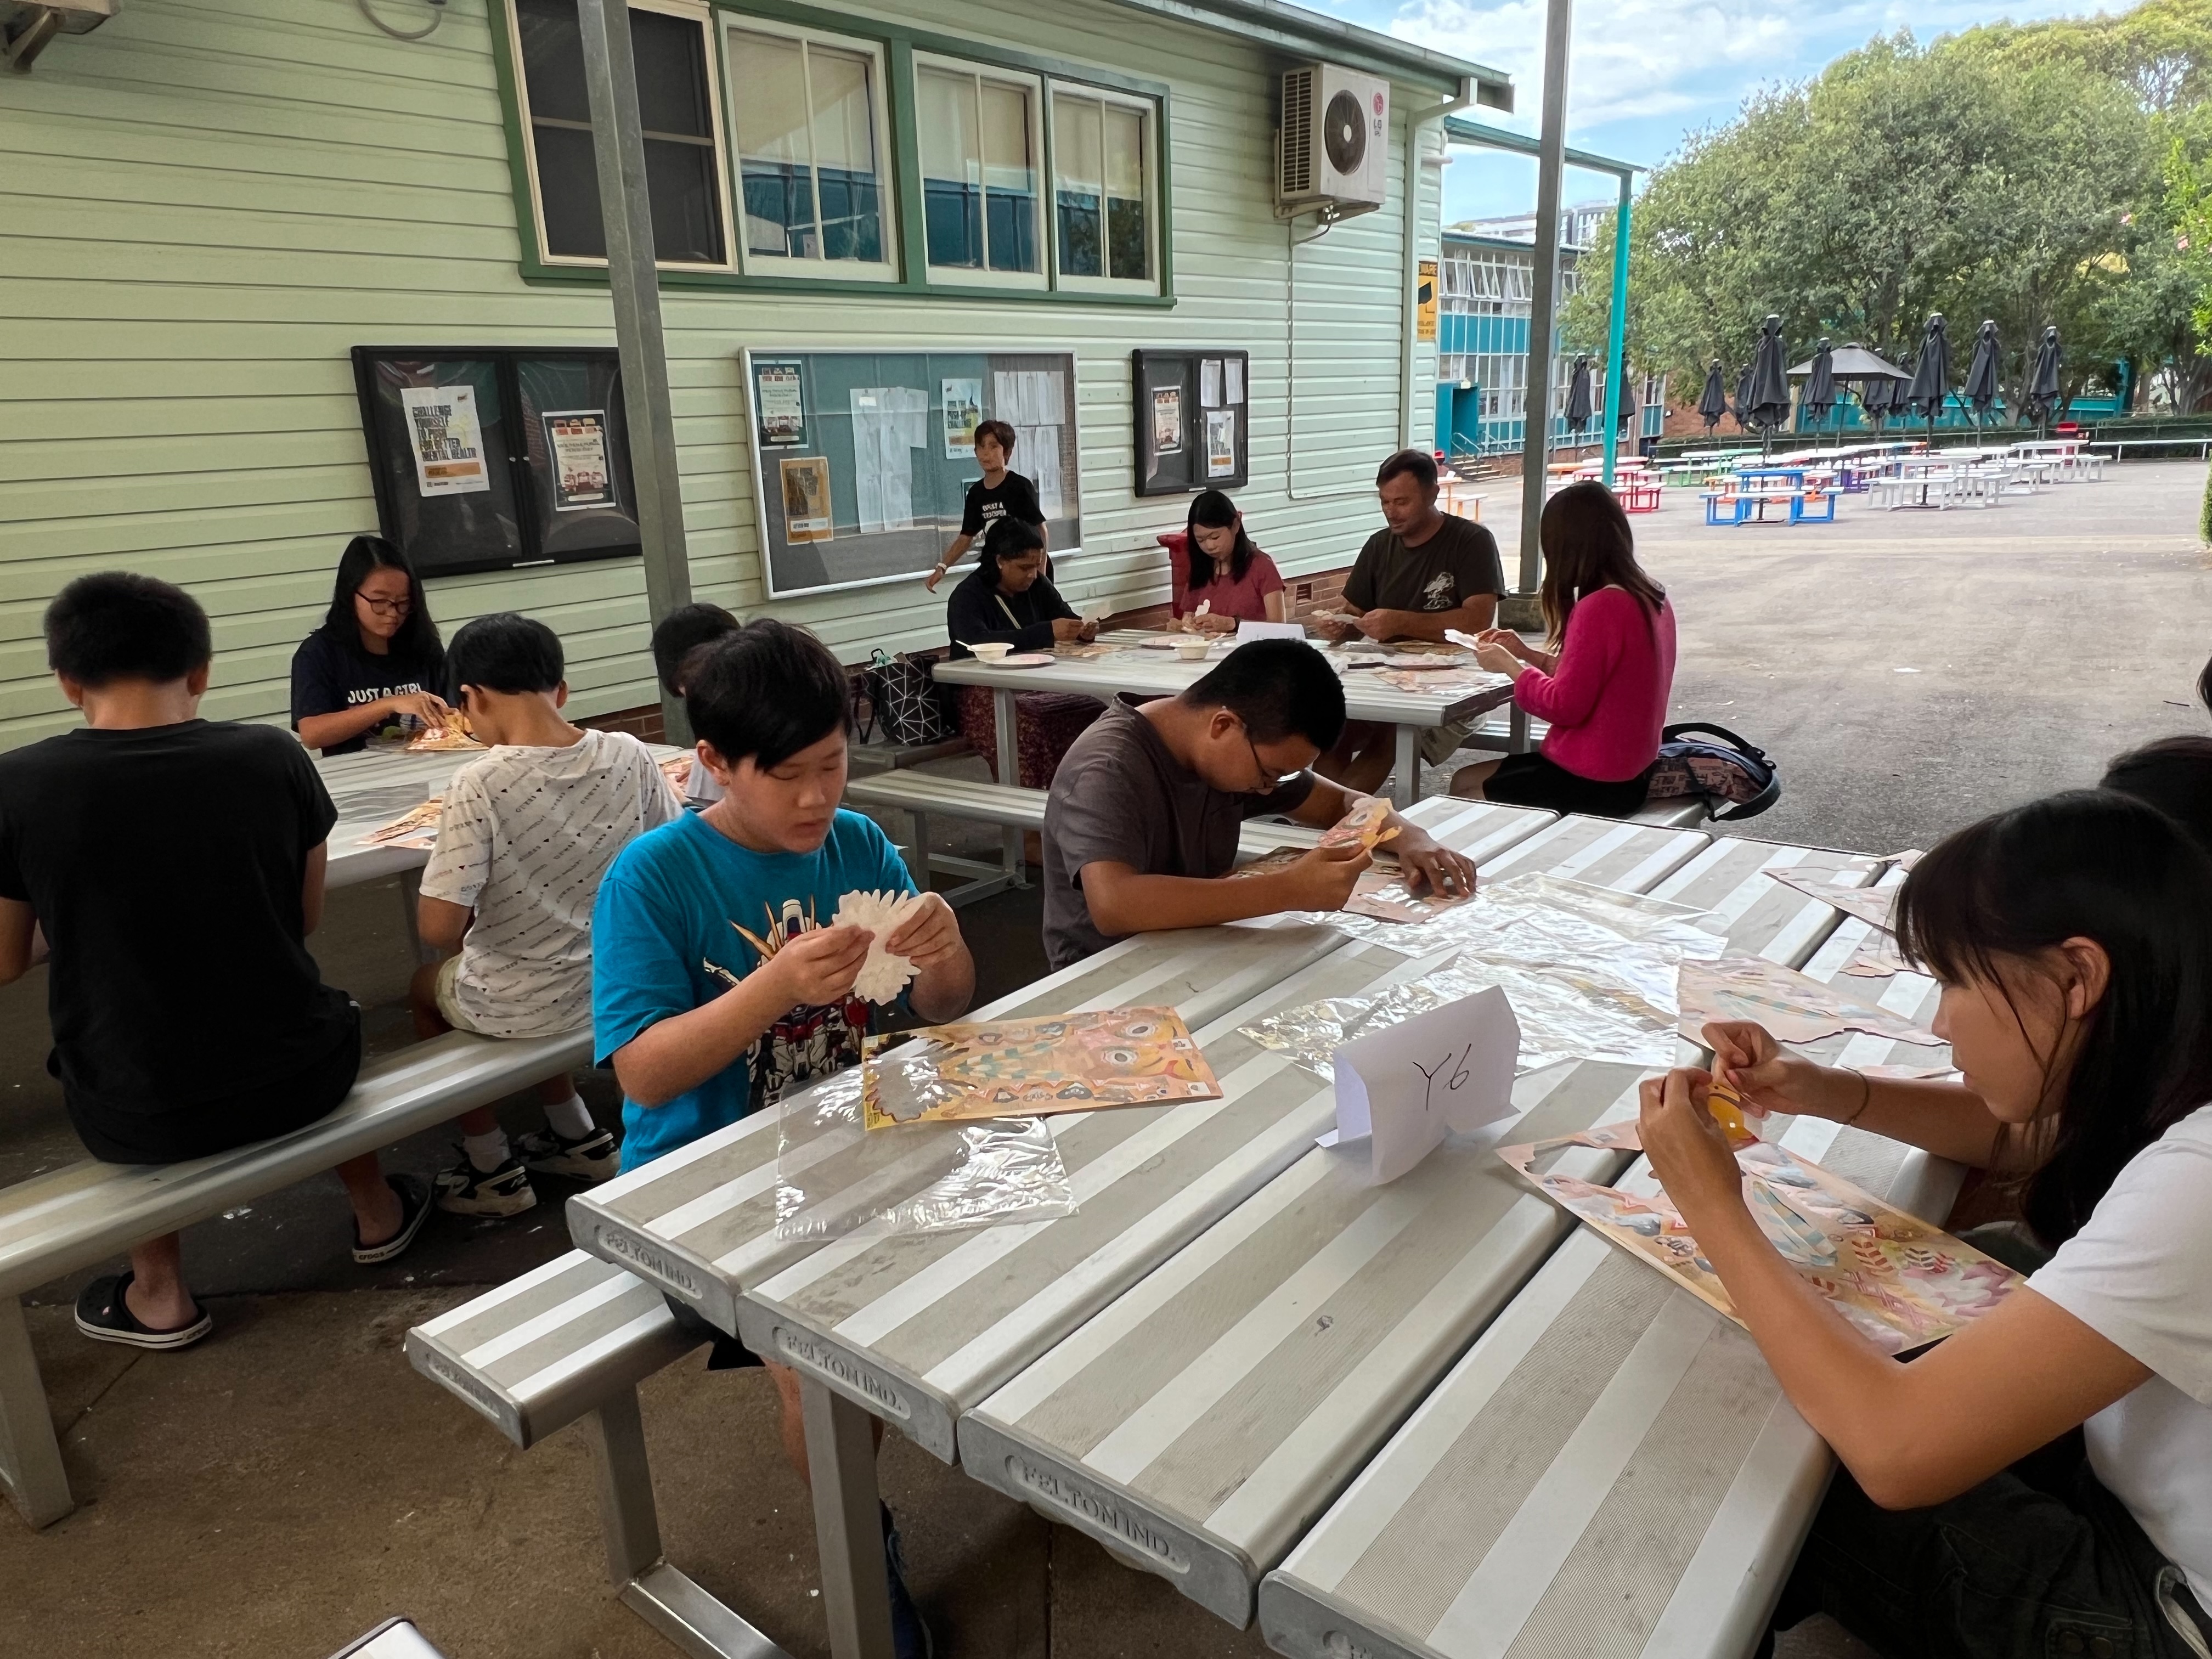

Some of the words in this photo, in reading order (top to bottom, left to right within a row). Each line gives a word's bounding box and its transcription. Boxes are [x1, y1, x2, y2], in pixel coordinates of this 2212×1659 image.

[347, 688, 379, 703] JUST
[382, 687, 392, 698] A
[1412, 1043, 1471, 1111] Y6
